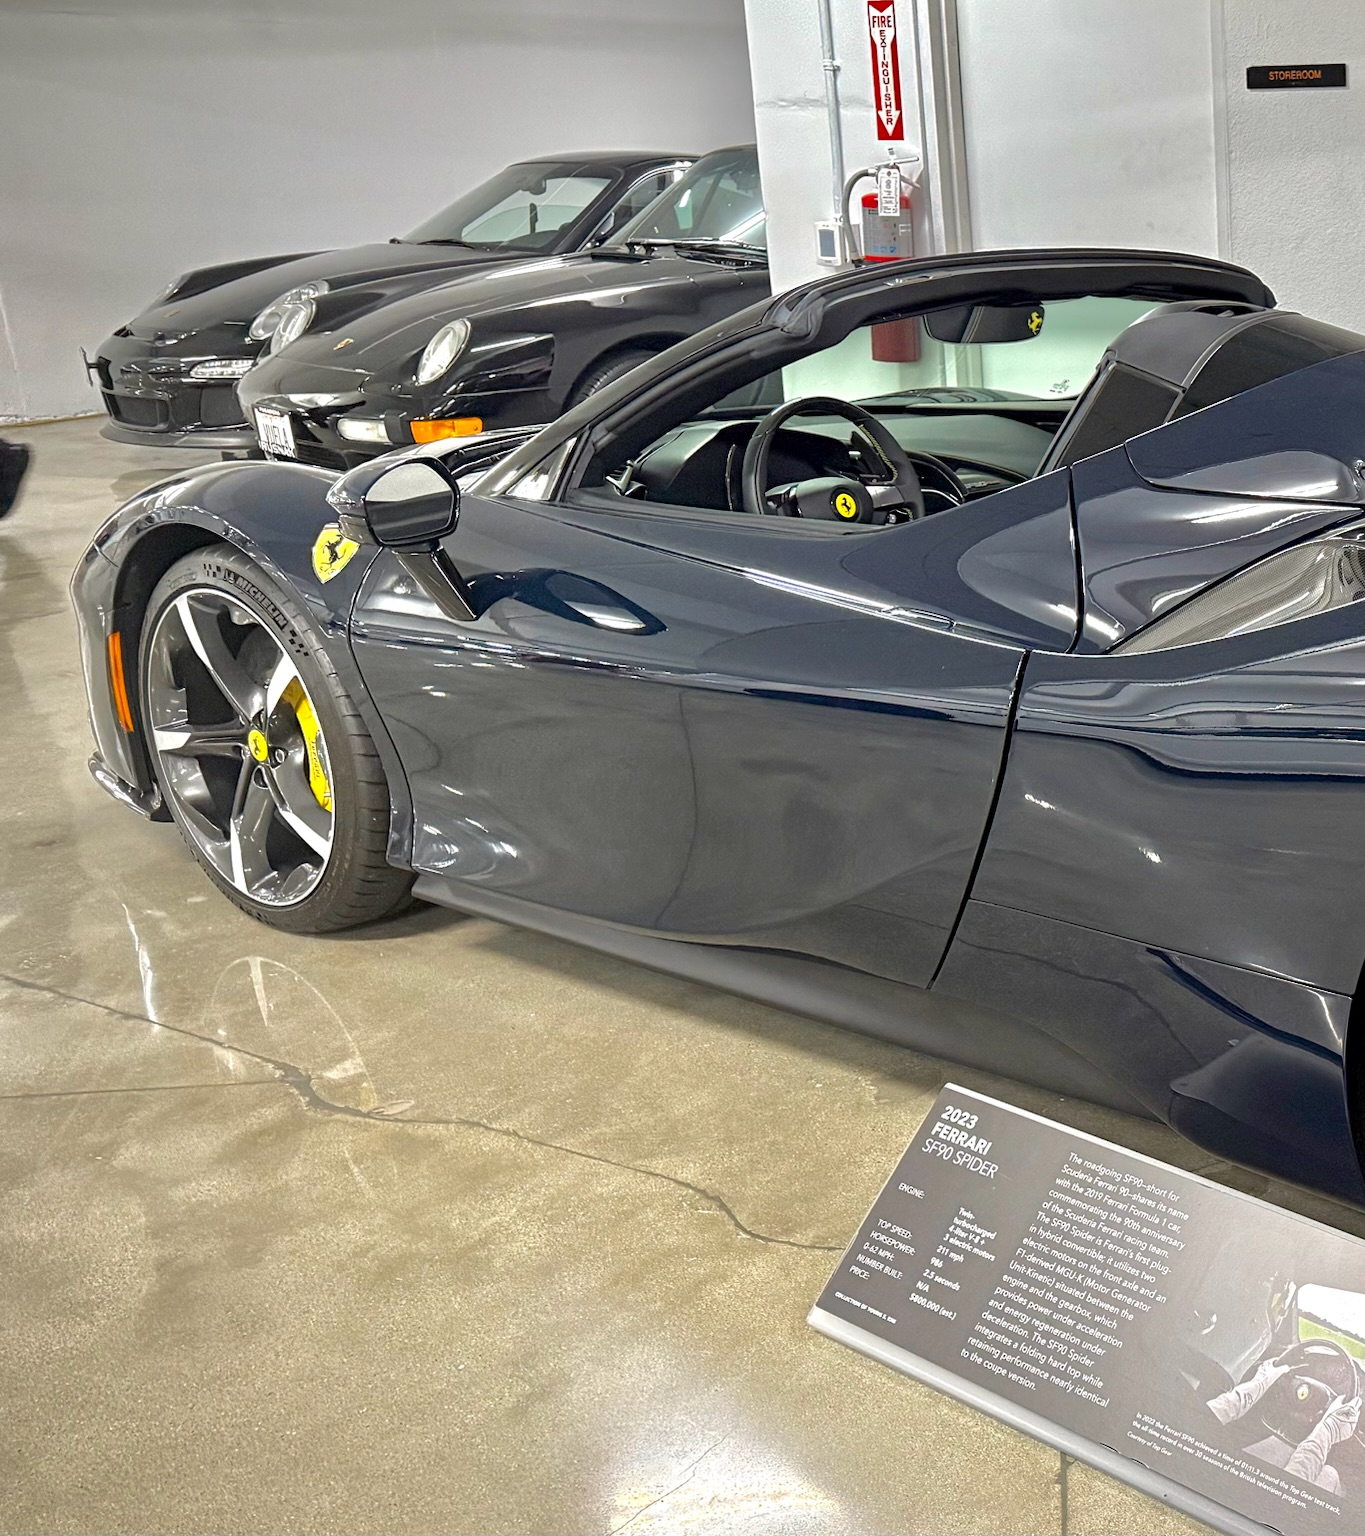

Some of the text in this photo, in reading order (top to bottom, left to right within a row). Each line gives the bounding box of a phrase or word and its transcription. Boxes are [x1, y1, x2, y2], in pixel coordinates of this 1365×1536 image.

[872, 15, 893, 29] FIRE
[878, 29, 894, 126] EXTINGUISHER
[1268, 69, 1323, 81] STOREROOM
[236, 577, 289, 628] MICHELIN
[930, 1121, 993, 1156] FERRARI
[940, 1105, 979, 1130] 2023
[921, 1137, 999, 1179] SF90 SPIDER
[1068, 1151, 1083, 1165] The
[1082, 1160, 1123, 1182] roadgoing
[1167, 1190, 1181, 1202] for
[898, 1182, 925, 1200] ENGINE:
[1055, 1177, 1182, 1234] with the 2019 Ferrari Formula 1 car,
[1060, 1163, 1094, 1183] Scuderia
[1092, 1176, 1120, 1193] Ferrari
[1156, 1201, 1168, 1212] its
[1166, 1207, 1190, 1221] name
[877, 1218, 913, 1240] TOP SPEED:
[952, 1216, 998, 1240] turbocharged
[958, 1206, 976, 1220] Twin-
[1041, 1200, 1169, 1259] of the Scuderia Ferrari racing team.
[1048, 1189, 1186, 1251] commemorating the 90th anniversary
[862, 1241, 895, 1262] 0-62 MPH:
[869, 1229, 916, 1256] HORSEPOWER:
[930, 1256, 944, 1269] 986
[936, 1244, 965, 1263] 211 mph
[942, 1232, 996, 1262] 3 electric motors
[1028, 1223, 1156, 1283] in hybrid convertible; it utilizes two
[1036, 1210, 1051, 1224] The
[1050, 1217, 1071, 1233] SF90
[1069, 1225, 1096, 1243] Spider
[1094, 1235, 1104, 1246] is
[1134, 1251, 1151, 1266] first
[1149, 1260, 1172, 1276] plug-
[848, 1264, 871, 1281] PRICE:
[855, 1253, 903, 1280] NUMBER BUILT:
[915, 1280, 930, 1293] N/A
[922, 1268, 961, 1292] 2.5 seconds
[1015, 1247, 1152, 1313] F1-derived MGU-K (Motor Generator
[1022, 1236, 1167, 1304] electric motors on the front axle and an
[908, 1292, 957, 1321] $800,000 (est.)
[1002, 1274, 1118, 1330] engine and the gearbox, which
[1009, 1259, 1134, 1321] Unit-Kinetic) situated between the
[981, 1309, 1095, 1368] deceleration. The SF90 Spider
[988, 1299, 1107, 1357] and energy regeneration under
[993, 1286, 1123, 1349] provides power under acceleration
[960, 1347, 1036, 1391] to the coupe version.
[967, 1336, 1111, 1408] retaining performance nearly identical
[973, 1321, 1104, 1389] integrates a folding hard top while
